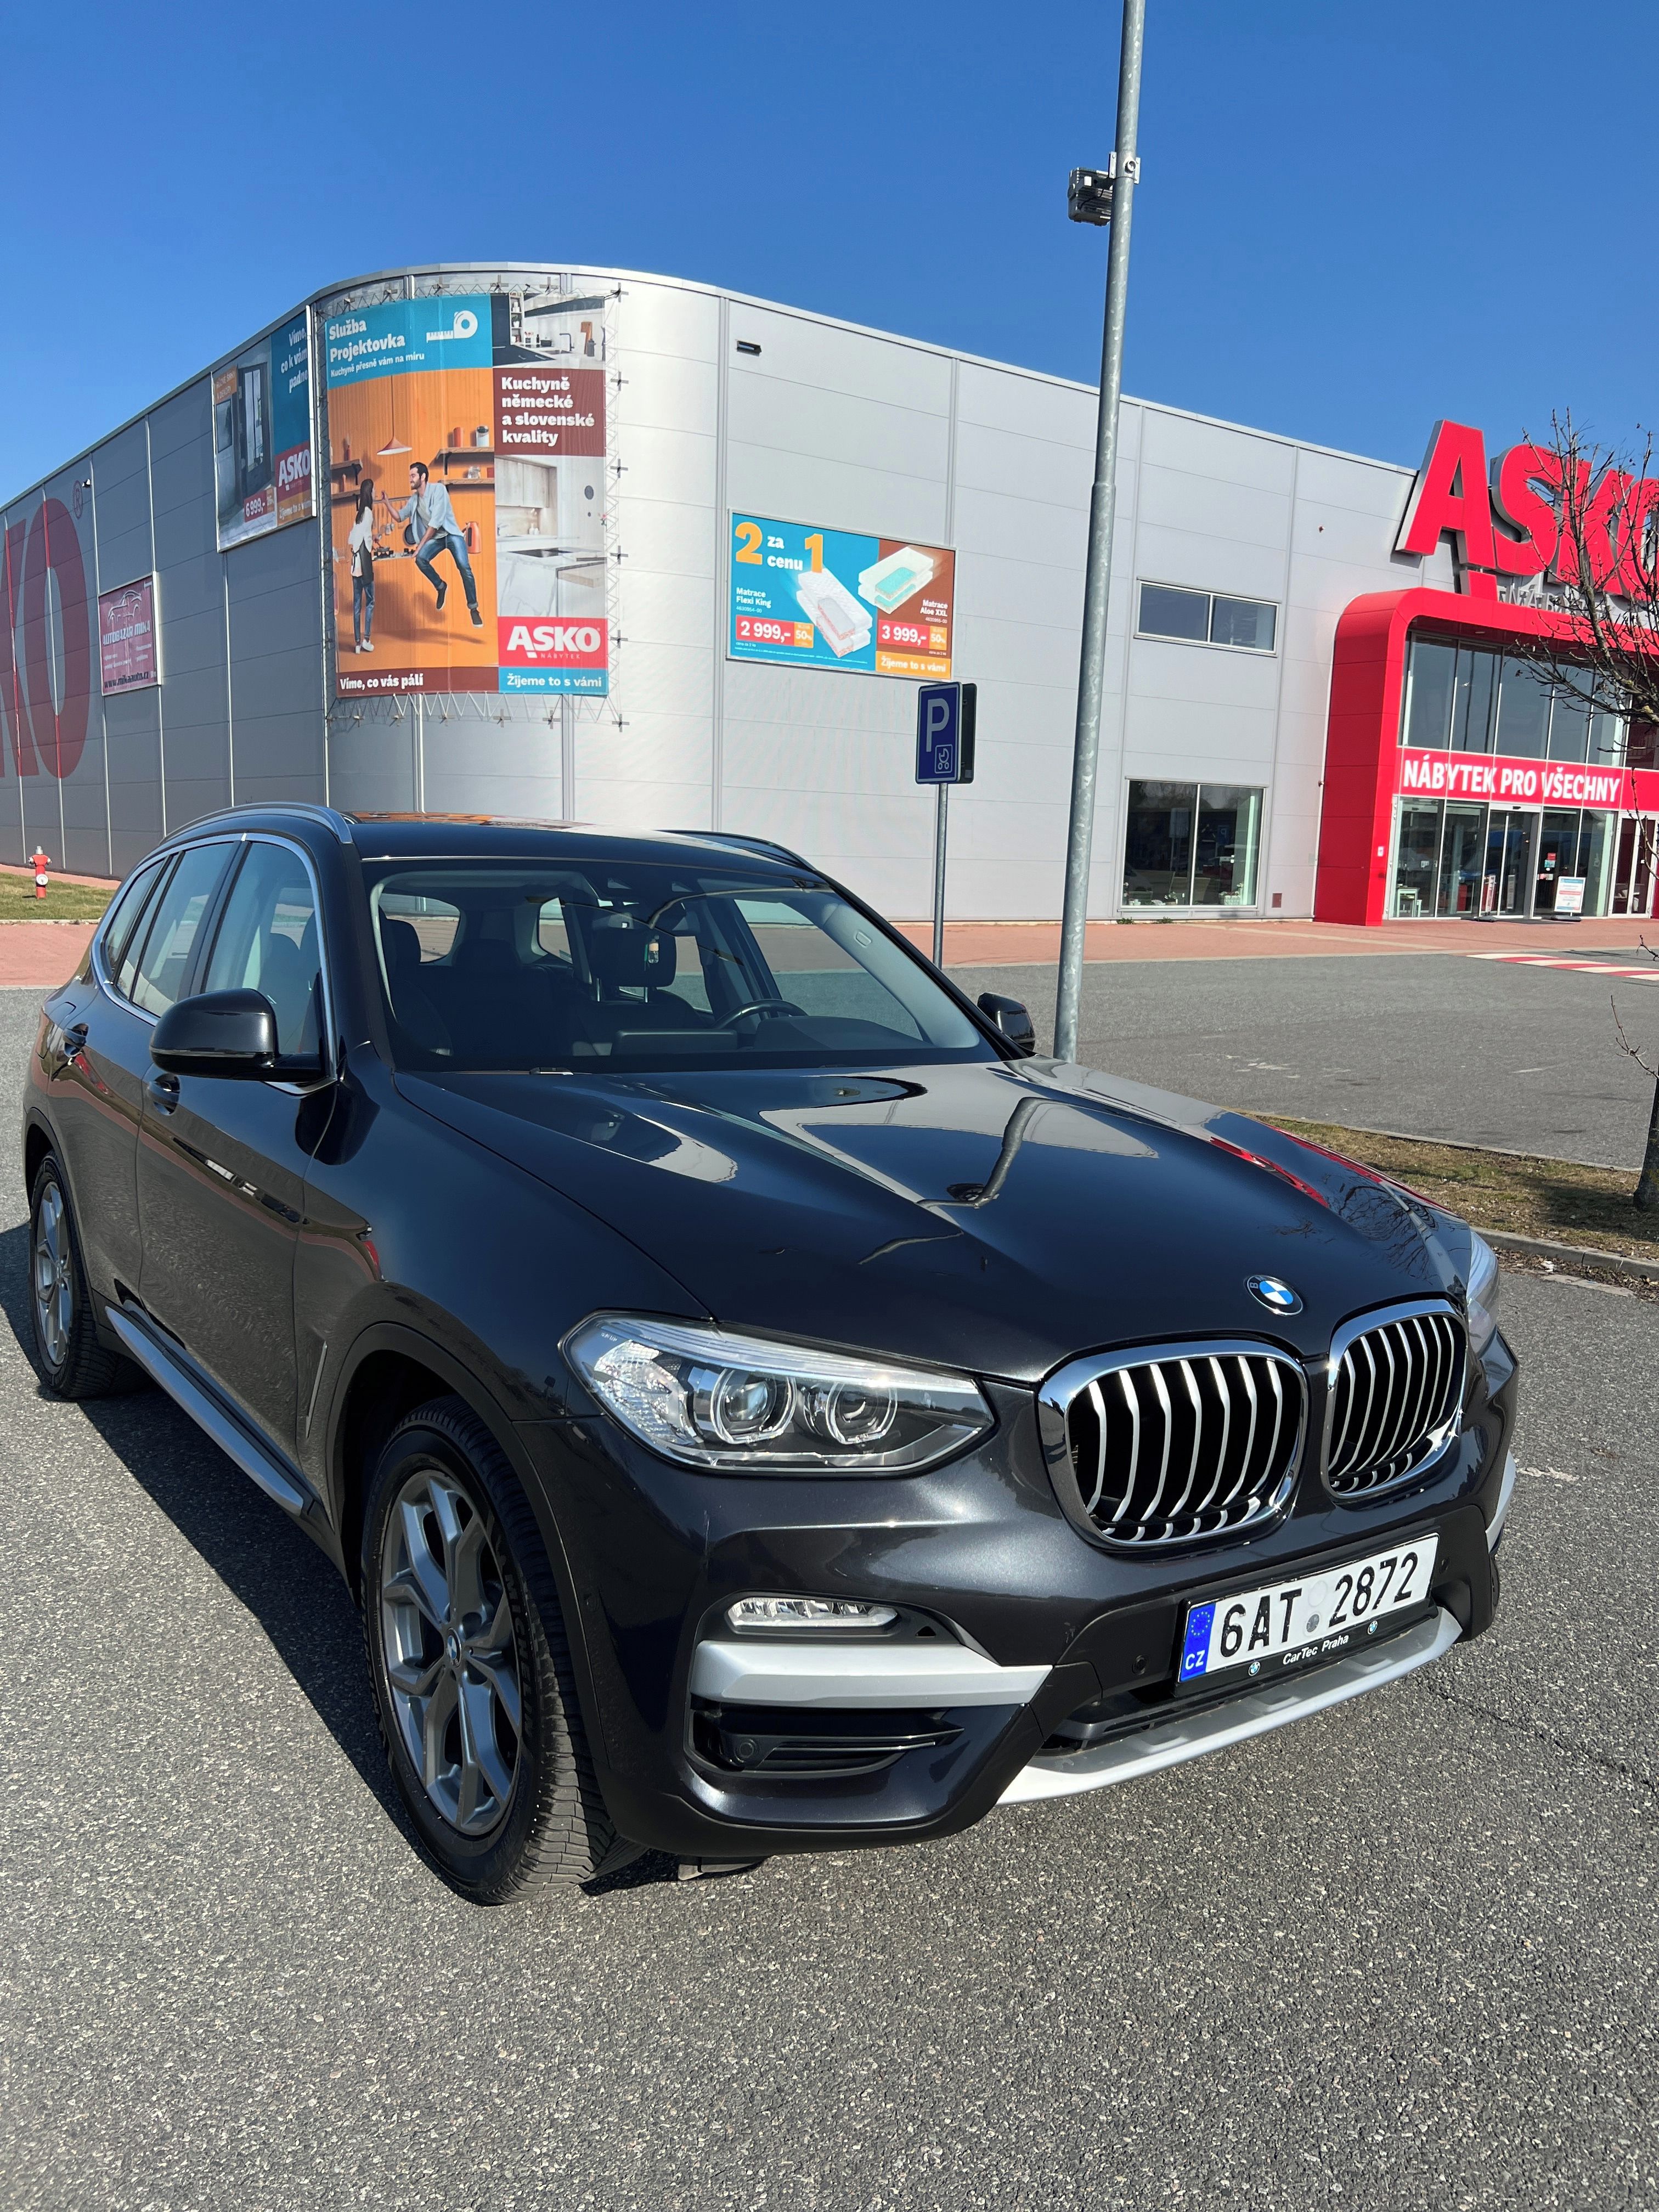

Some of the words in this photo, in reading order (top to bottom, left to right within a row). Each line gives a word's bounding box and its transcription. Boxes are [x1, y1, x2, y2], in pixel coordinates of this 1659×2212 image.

[329, 319, 366, 340] Služba
[330, 334, 405, 363] Projektovka
[281, 360, 288, 373] co
[289, 354, 294, 369] k
[331, 363, 354, 377] Kuchyně
[356, 358, 377, 373] přesně
[379, 356, 393, 366] vám
[405, 352, 425, 361] míru
[501, 376, 571, 393] Kuchyně
[501, 393, 574, 408] německé
[501, 415, 512, 426] a
[515, 412, 595, 427] slovenské
[502, 430, 558, 447] kvality
[278, 449, 311, 491] ASKO
[735, 522, 763, 565] 2
[767, 535, 785, 549] za
[805, 533, 823, 573] 1
[767, 555, 803, 571] cenu
[736, 587, 766, 598] Matrace
[736, 596, 754, 605] Flexi
[755, 598, 771, 609] King
[920, 607, 934, 615] Aloe
[923, 599, 948, 609] Matrace
[506, 625, 601, 658] ASKO
[741, 620, 751, 636] 2
[753, 622, 791, 643] 999,-
[882, 625, 891, 640] 3
[893, 627, 927, 646] 999,-
[881, 656, 908, 669] Žijeme
[910, 661, 918, 669] to
[927, 663, 946, 672] vámi
[340, 678, 365, 690] Víme,
[366, 678, 379, 688] co
[380, 674, 399, 687] vás
[401, 673, 424, 690] pálí
[507, 673, 545, 688] Žijeme
[548, 676, 561, 686] to
[564, 678, 571, 687] s
[573, 676, 602, 687] vámi
[926, 698, 950, 752] P
[1402, 754, 1497, 793] NÁBYTEK
[1499, 768, 1536, 796] PRO
[1541, 766, 1620, 802] VŠECHNY
[1220, 1588, 1302, 1658] 6AT
[1328, 1551, 1419, 1627] 2872
[1283, 1645, 1318, 1666] CarTec
[1322, 1633, 1350, 1652] Praha
[1185, 1649, 1206, 1671] CZ
